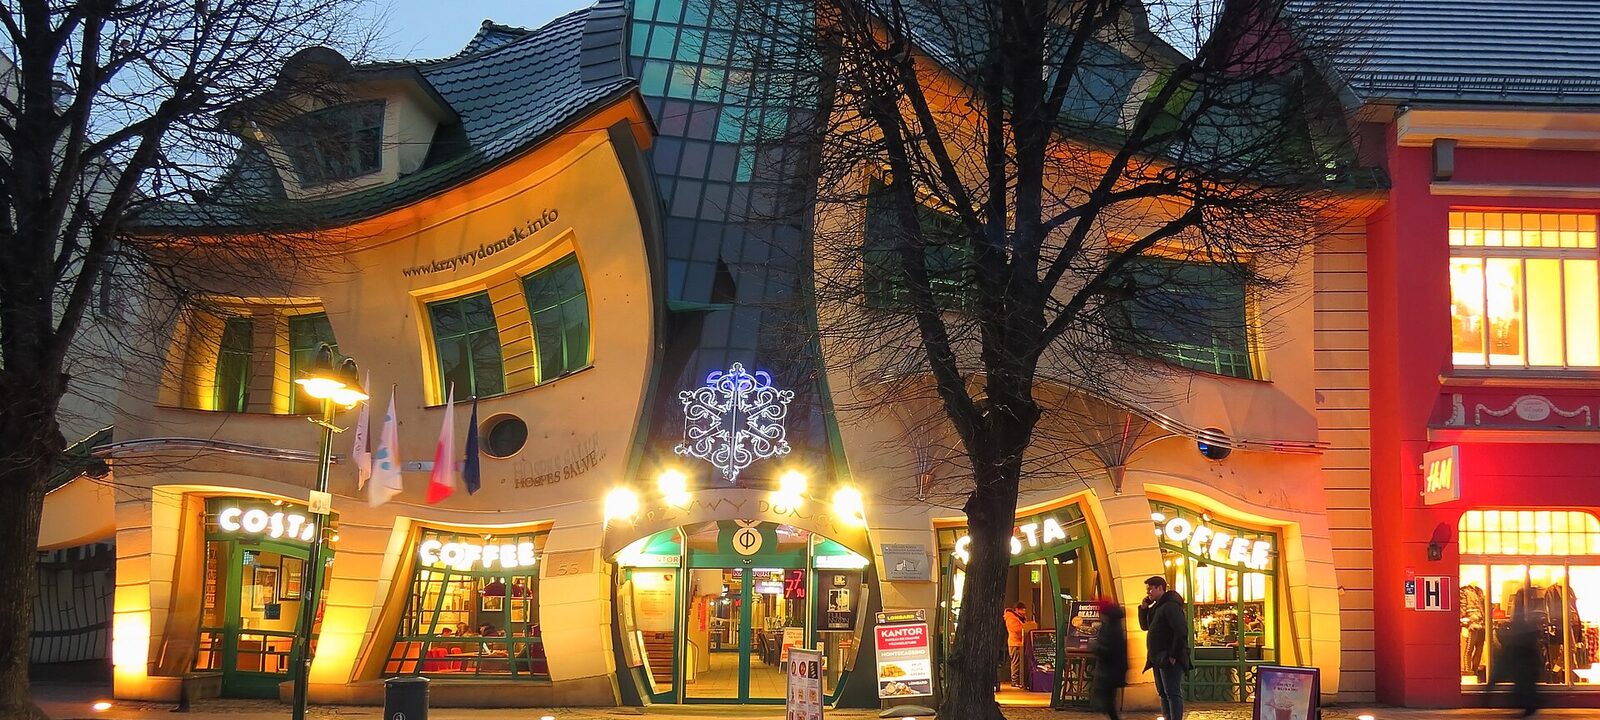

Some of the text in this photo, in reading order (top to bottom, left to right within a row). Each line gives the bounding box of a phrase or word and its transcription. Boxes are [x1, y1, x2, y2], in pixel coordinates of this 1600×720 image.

[402, 208, 558, 277] www.krzywydomek.info
[515, 472, 561, 488] HOSPES
[1427, 457, 1452, 493] H&M
[420, 540, 536, 568] COFFEE
[881, 627, 923, 637] KANTOR
